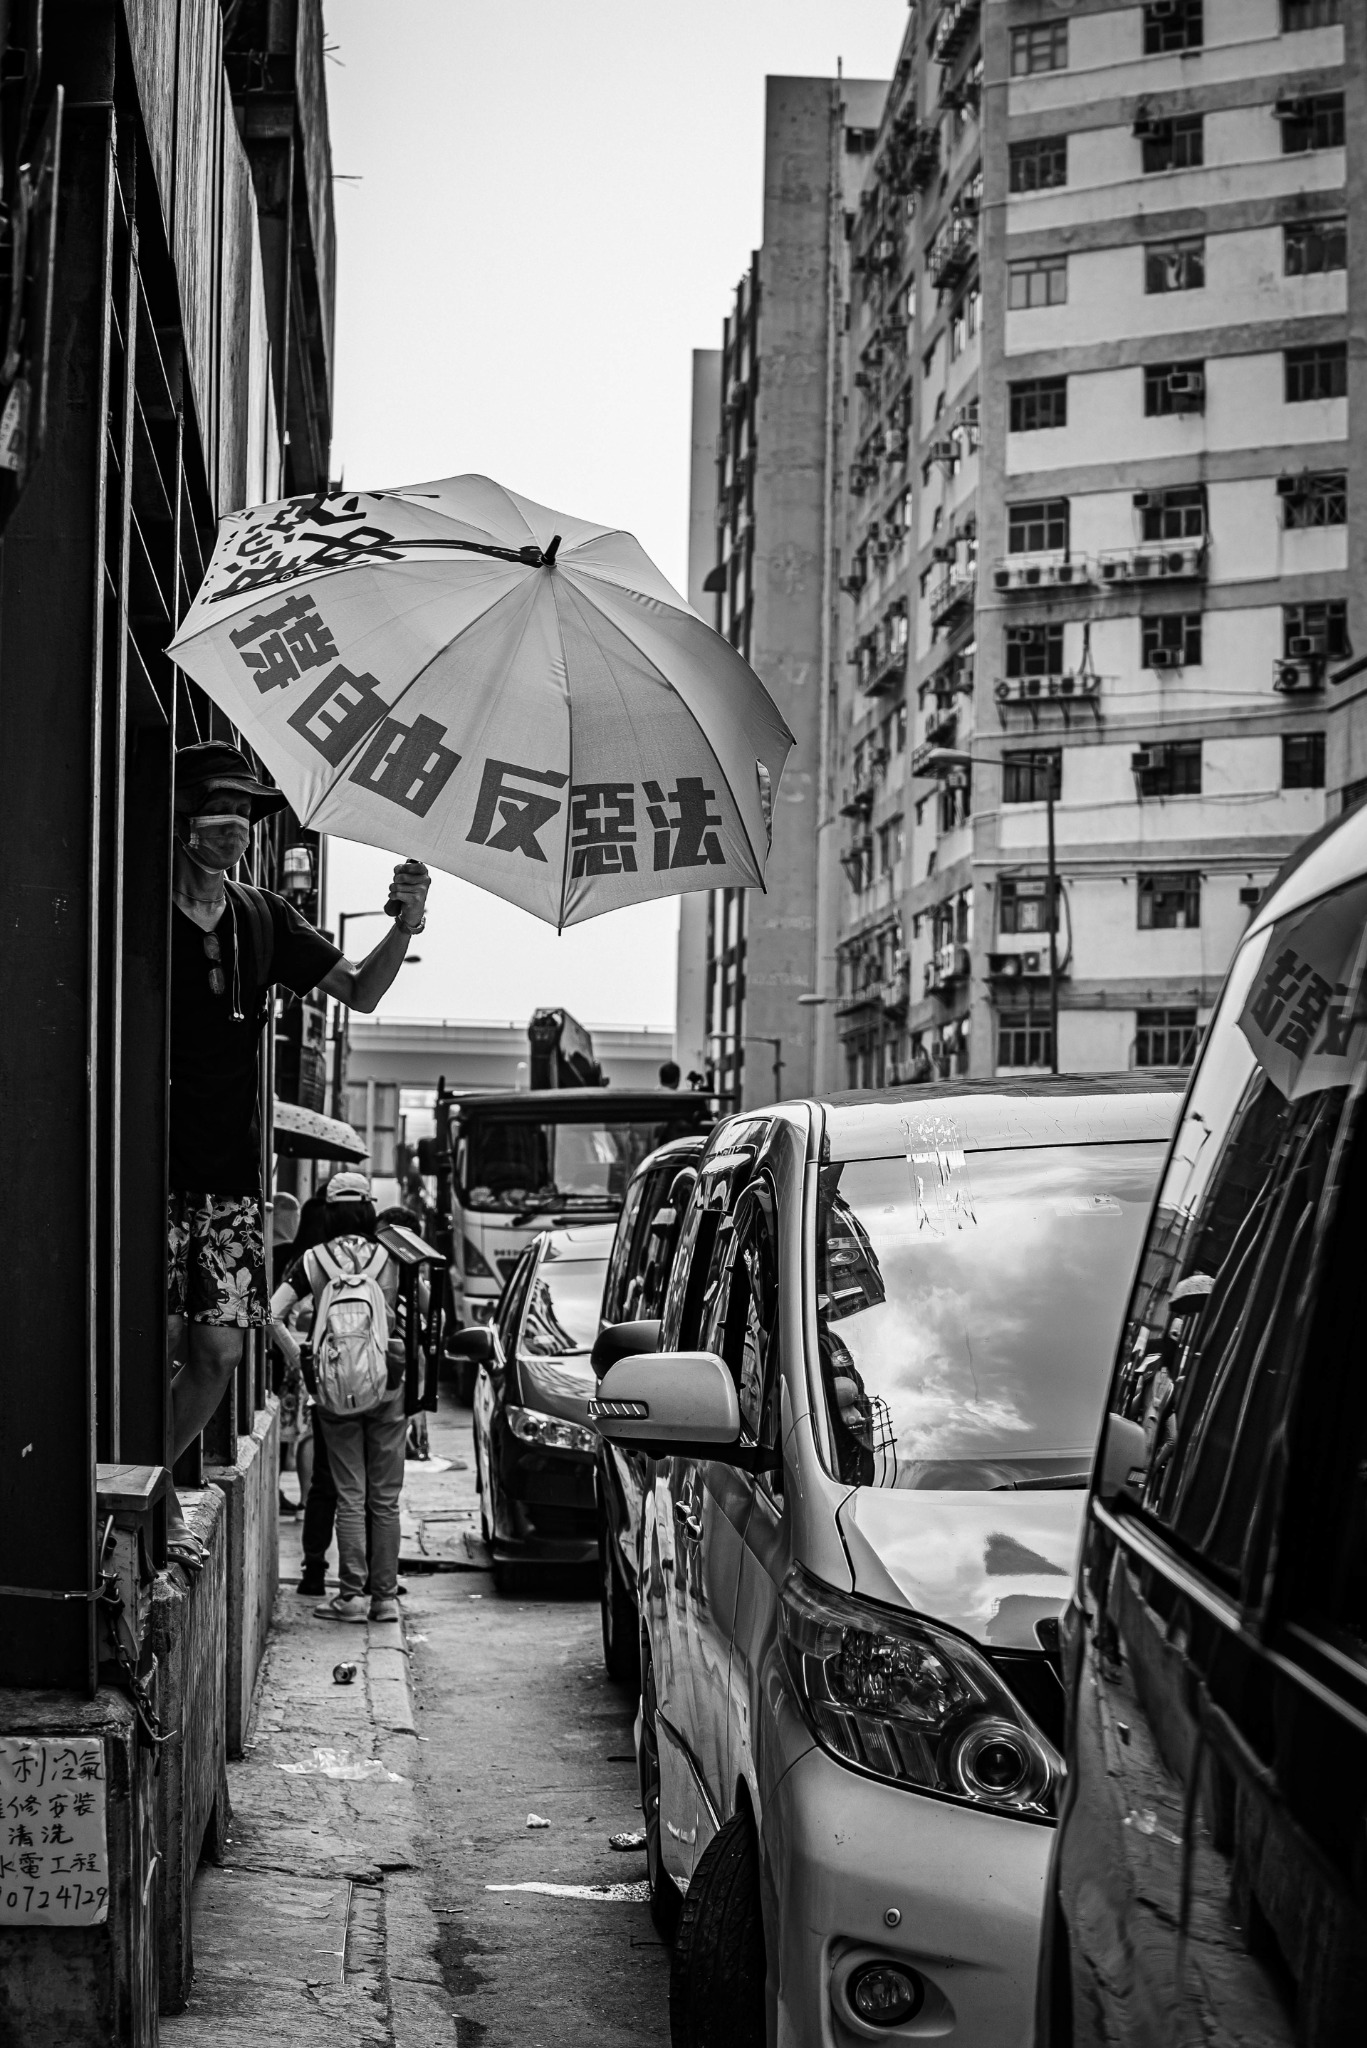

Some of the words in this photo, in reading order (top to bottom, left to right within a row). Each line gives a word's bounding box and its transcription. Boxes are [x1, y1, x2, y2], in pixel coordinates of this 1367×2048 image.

[0, 1746, 105, 1787] 利冷氣
[9, 1824, 73, 1846] 清洗
[0, 1884, 107, 1912] 0724729
